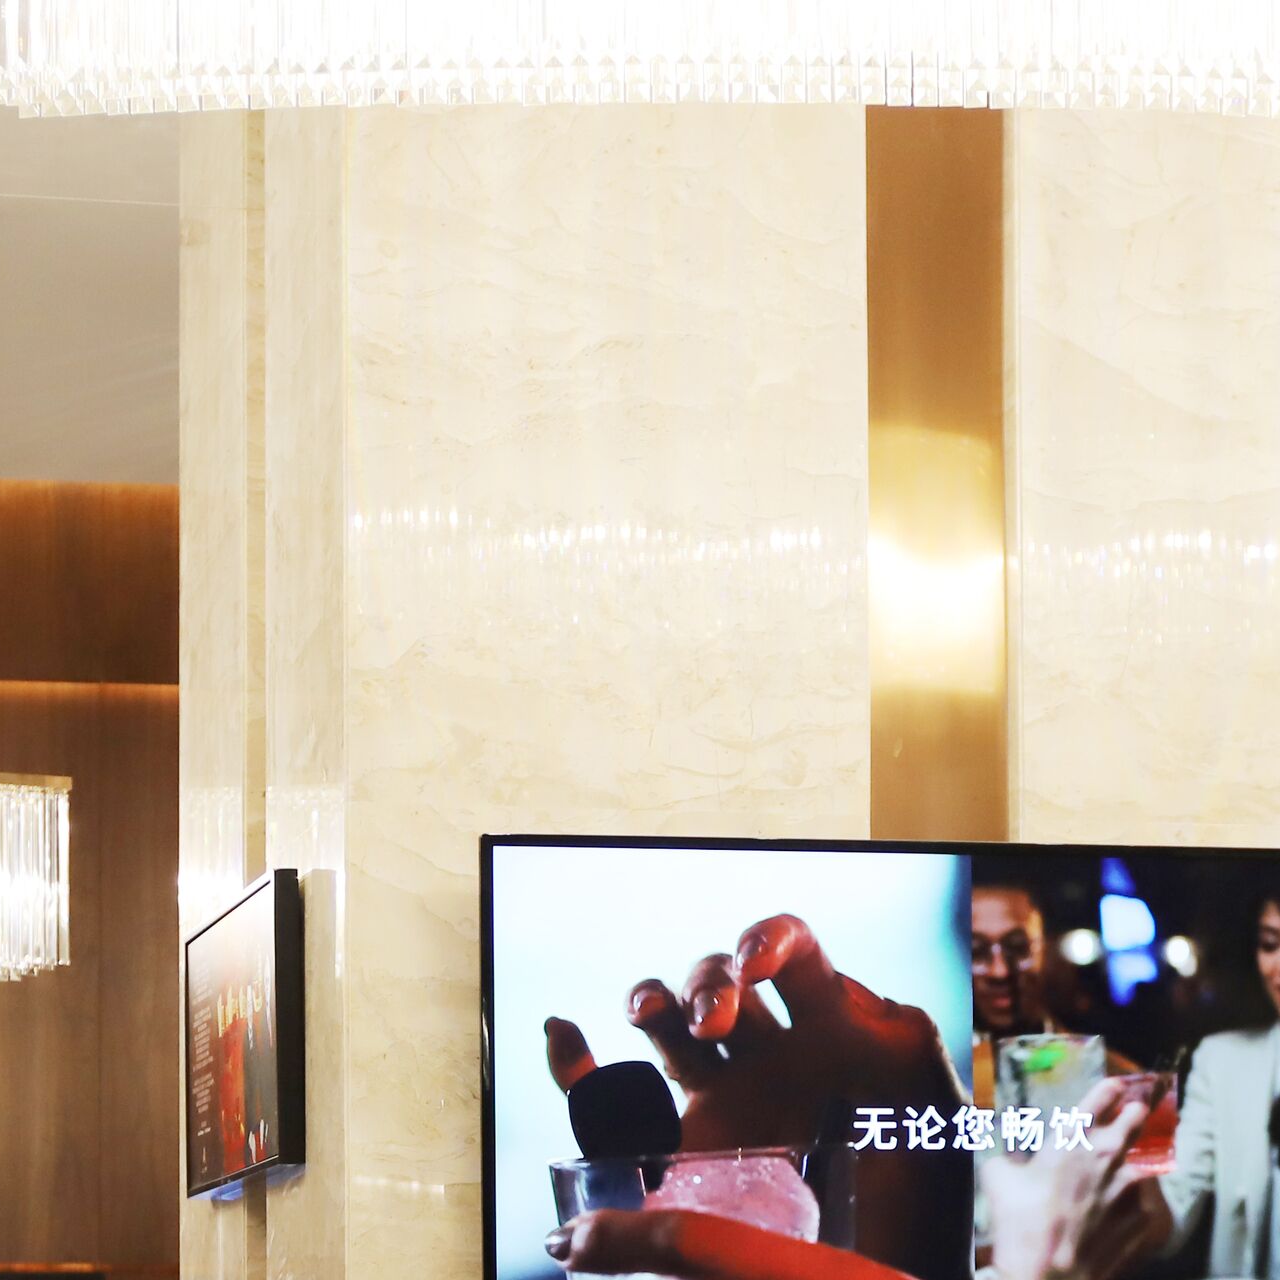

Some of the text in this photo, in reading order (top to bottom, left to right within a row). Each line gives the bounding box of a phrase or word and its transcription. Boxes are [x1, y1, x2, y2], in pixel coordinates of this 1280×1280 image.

[852, 1104, 1095, 1152] 无论您畅饮
